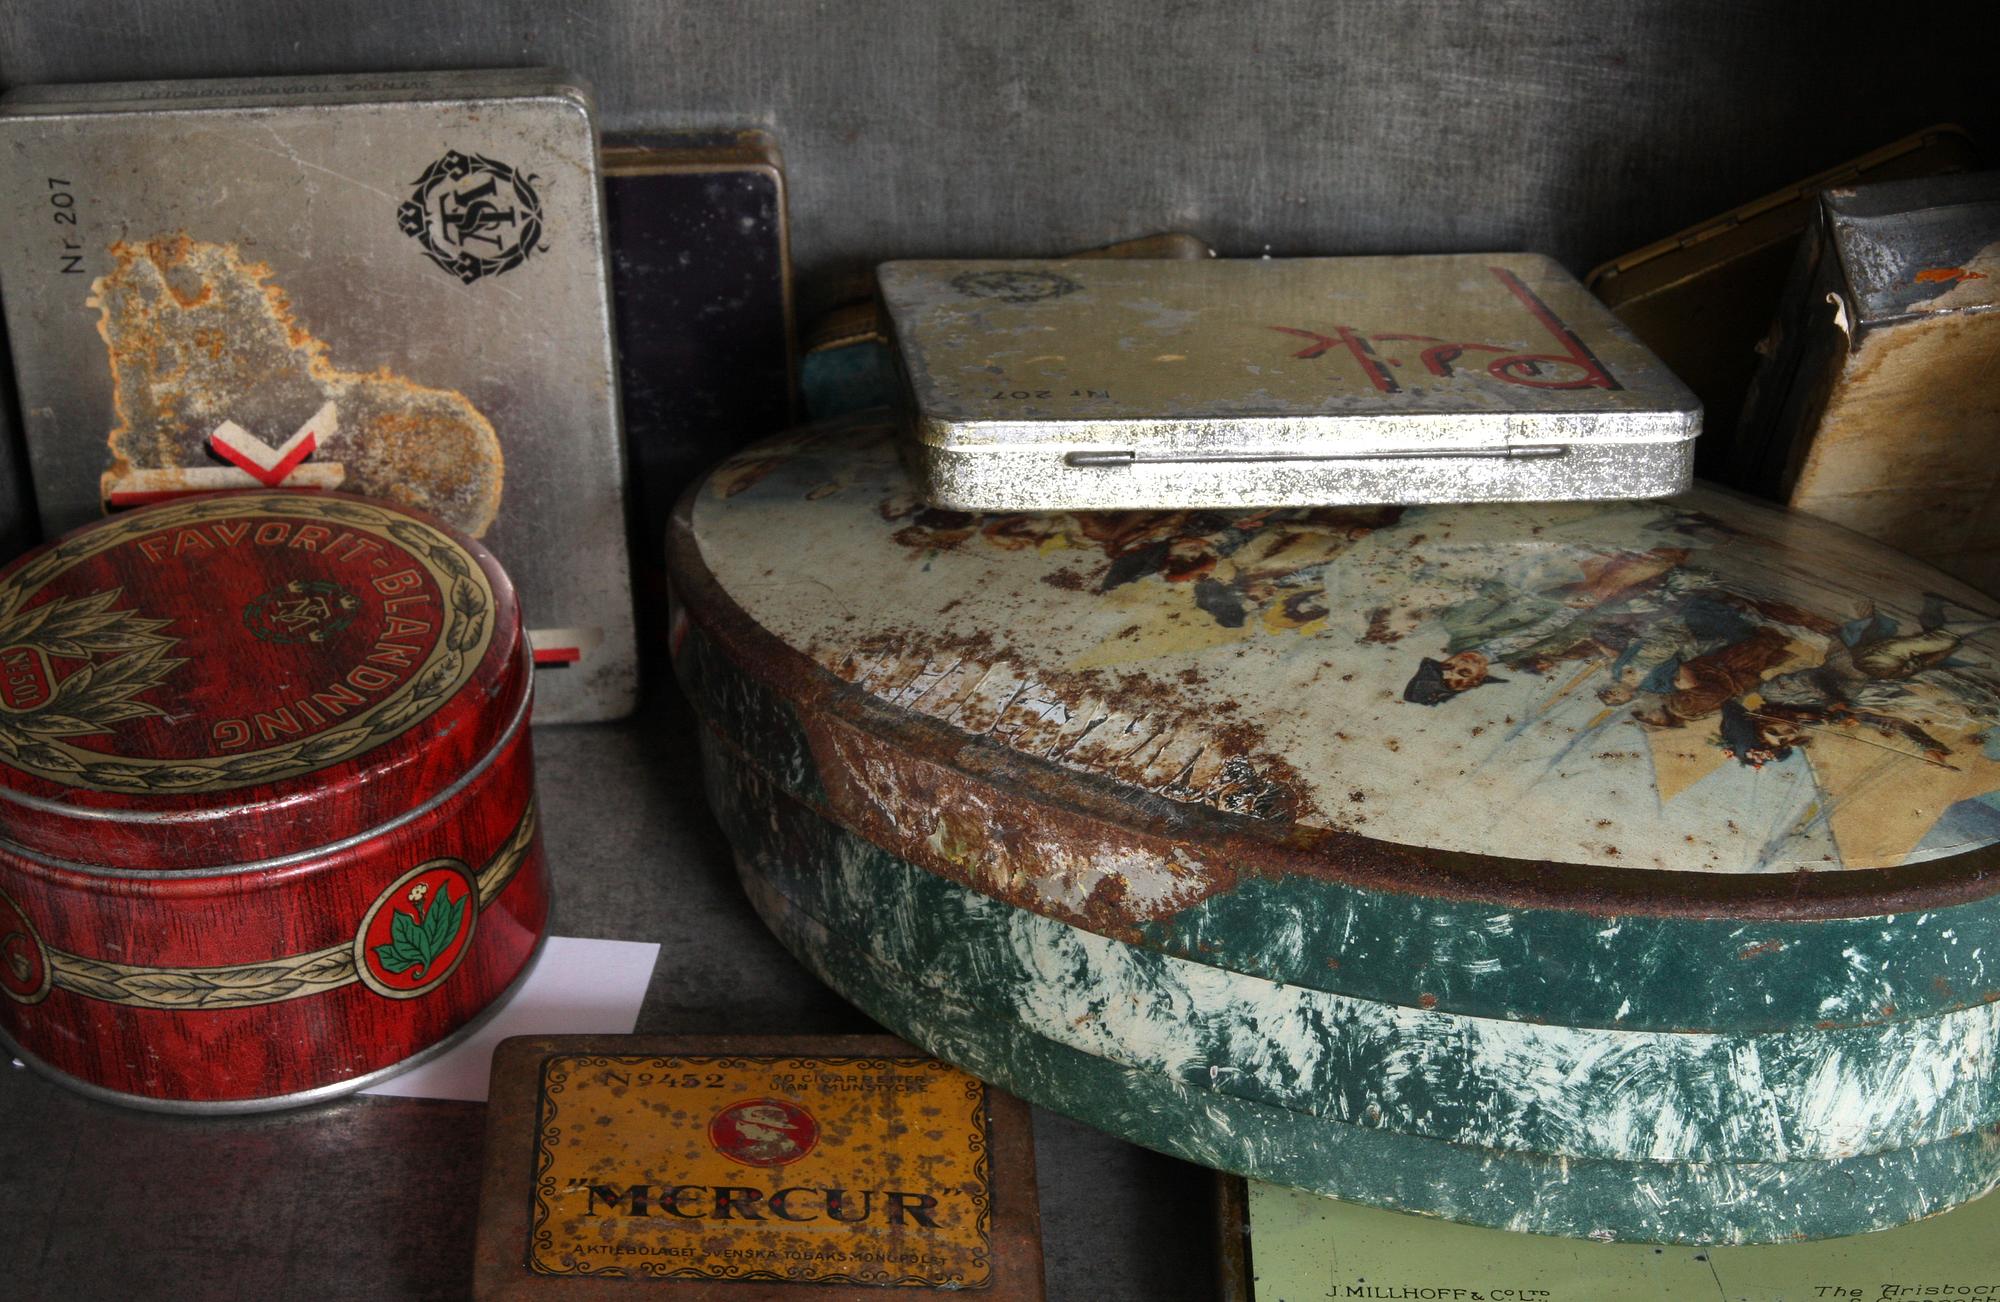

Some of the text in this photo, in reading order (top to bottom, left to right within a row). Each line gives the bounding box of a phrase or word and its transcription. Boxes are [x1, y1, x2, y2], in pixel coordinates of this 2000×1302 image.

[48, 178, 85, 274] Nr 207
[991, 389, 1052, 400] 207
[573, 1244, 697, 1258] AKTIEBOLAGET
[702, 1247, 777, 1260] SVENSKA
[1470, 1291, 1486, 1301] &
[1814, 1286, 1864, 1298] The
